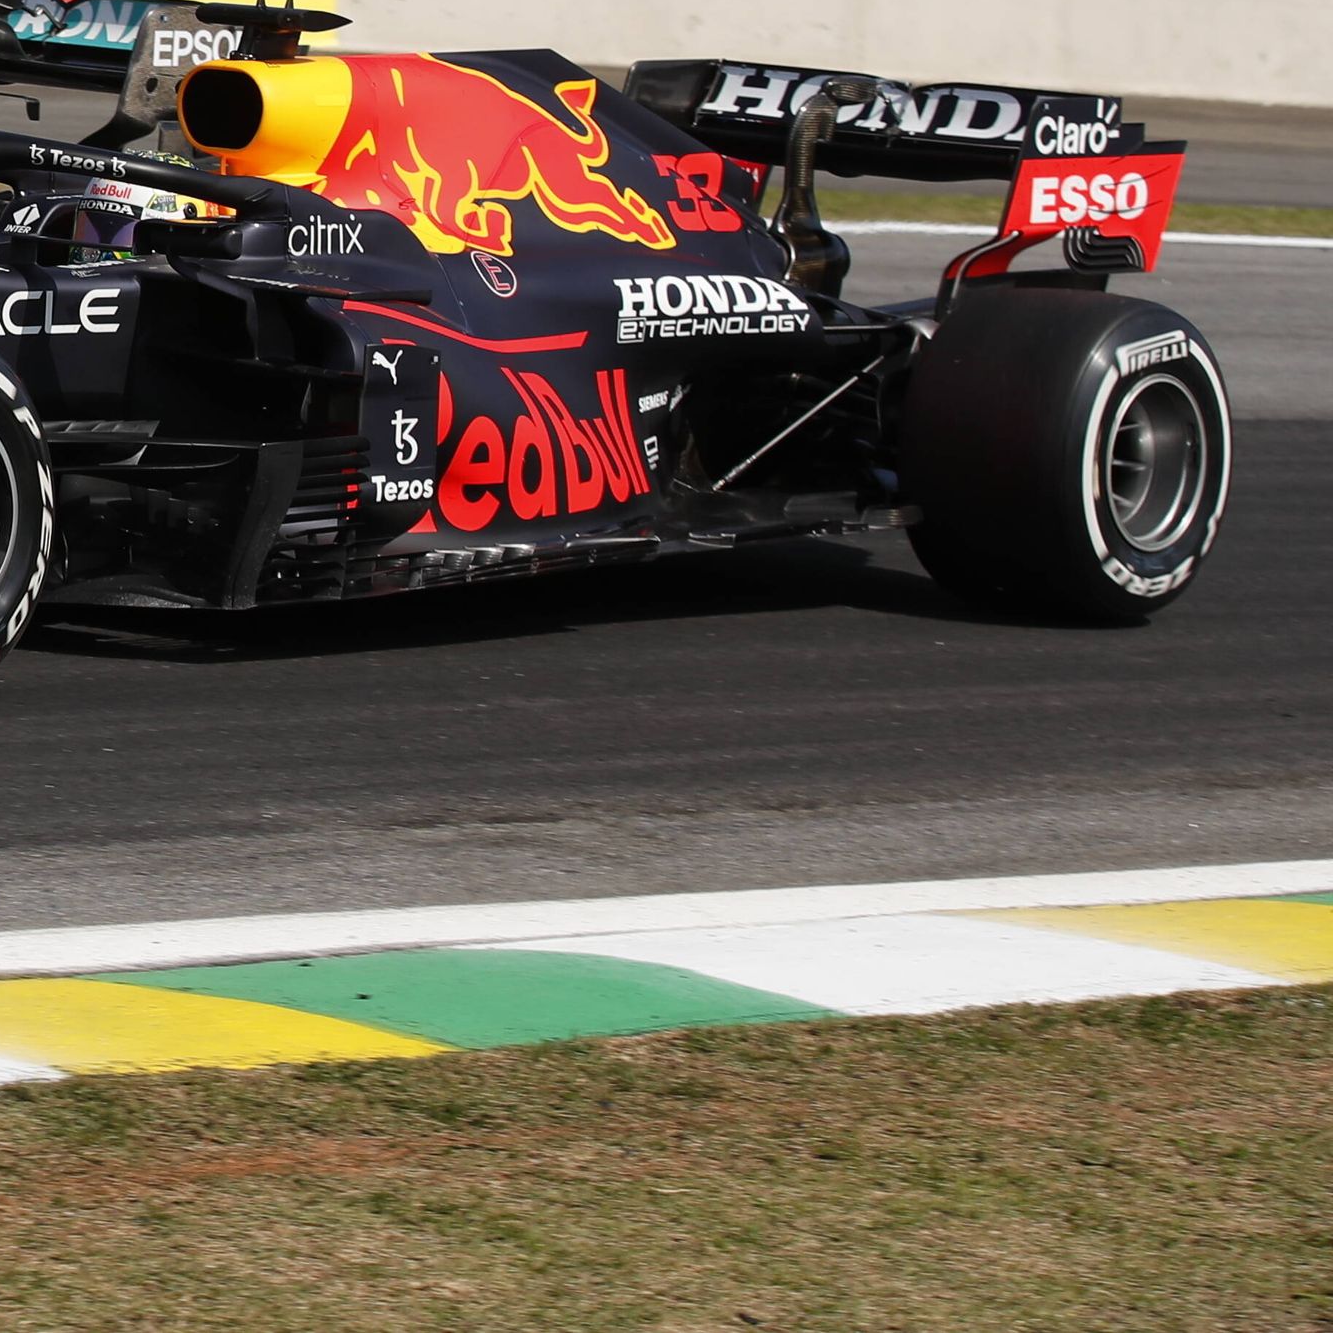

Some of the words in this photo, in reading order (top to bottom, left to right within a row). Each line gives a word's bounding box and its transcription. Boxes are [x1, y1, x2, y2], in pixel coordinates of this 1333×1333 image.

[701, 65, 1024, 141] HOND
[1034, 114, 1107, 154] Claro
[50, 149, 105, 172] Tezos
[79, 199, 135, 216] HONDA
[651, 152, 743, 232] 33
[1030, 172, 1148, 224] ESSO
[4, 224, 32, 234] INTER
[288, 213, 364, 258] citrix
[613, 274, 809, 317] HONDA
[1116, 329, 1188, 378] PIRELLI
[638, 390, 669, 413] SIEMENS
[371, 475, 434, 503] Tezos
